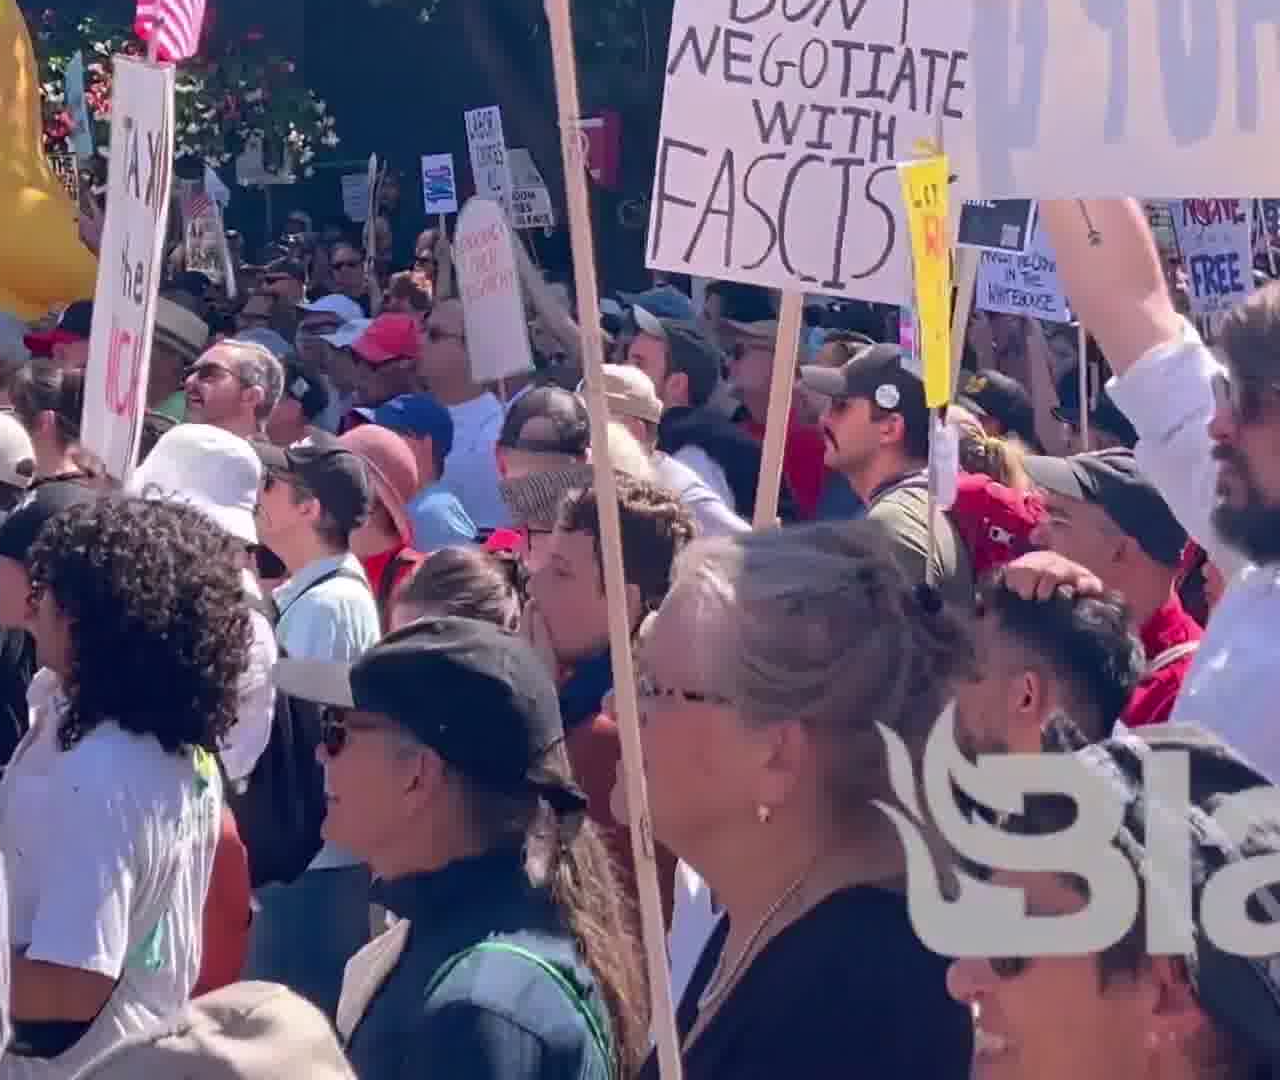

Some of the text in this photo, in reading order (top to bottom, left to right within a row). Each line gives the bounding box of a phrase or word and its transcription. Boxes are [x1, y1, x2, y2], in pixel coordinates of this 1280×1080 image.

[666, 23, 969, 120] NEGOTIATE
[751, 97, 897, 164] WITH
[646, 137, 898, 291] FASCIS
[1189, 253, 1244, 297] FREE
